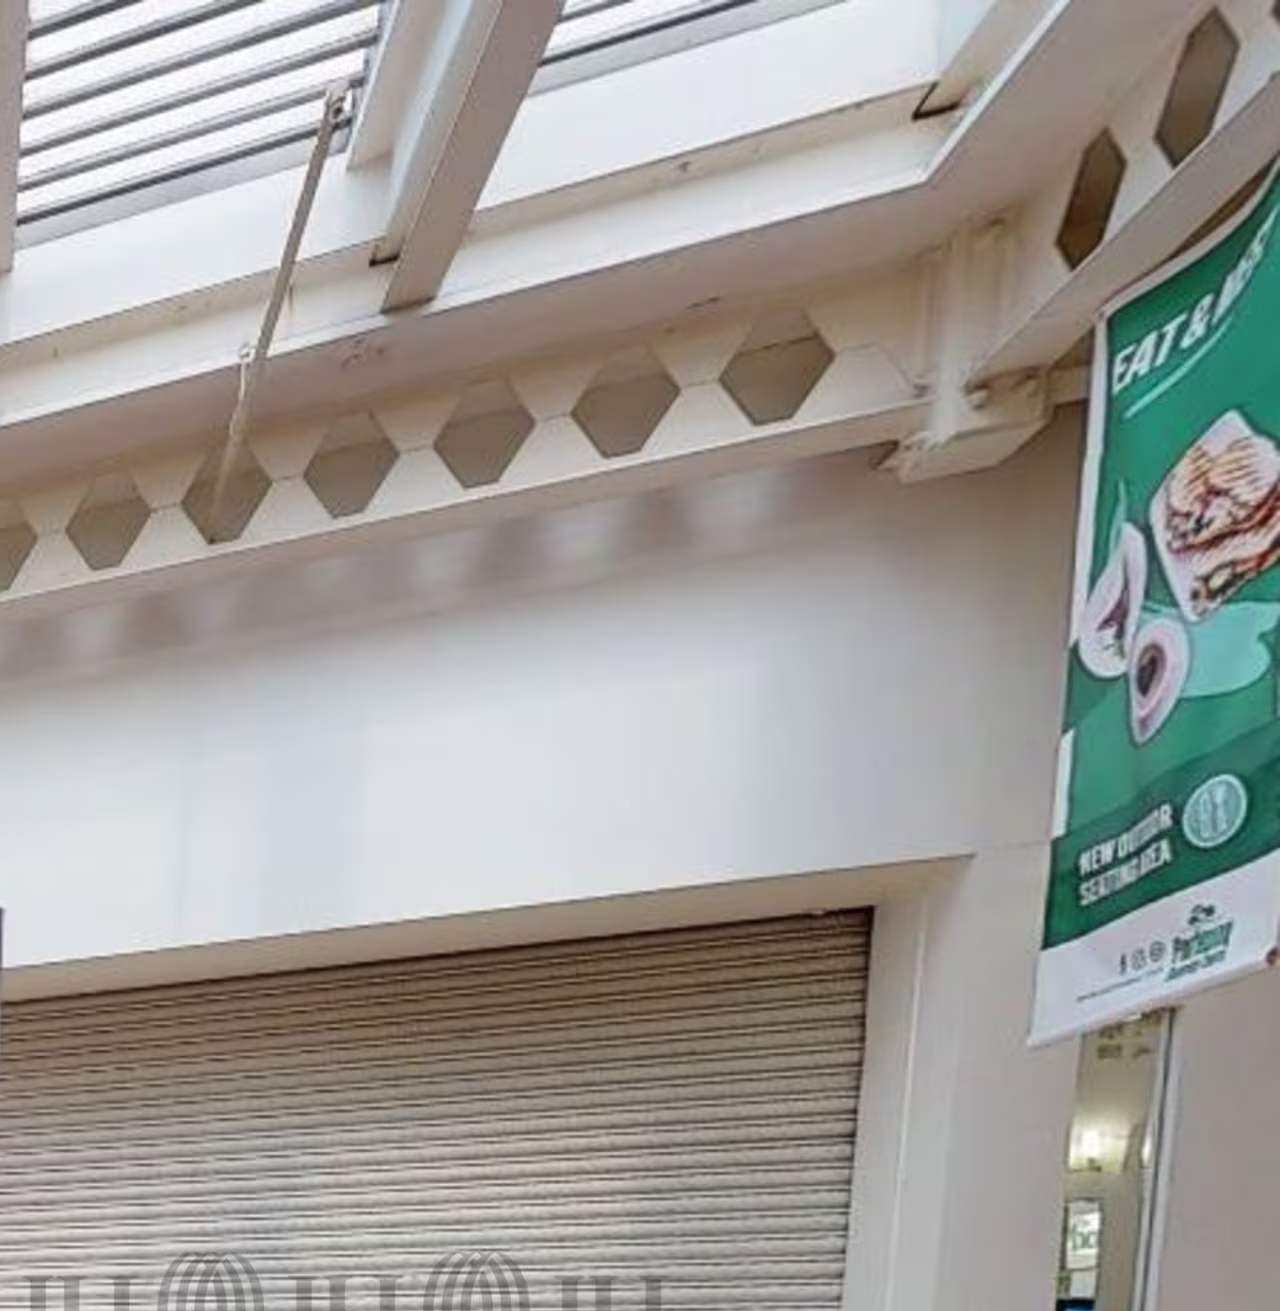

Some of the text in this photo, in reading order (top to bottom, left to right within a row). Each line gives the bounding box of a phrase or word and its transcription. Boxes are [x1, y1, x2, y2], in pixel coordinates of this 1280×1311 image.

[1113, 313, 1186, 395] EAT
[1181, 293, 1215, 349] &
[1079, 839, 1117, 877] NEW
